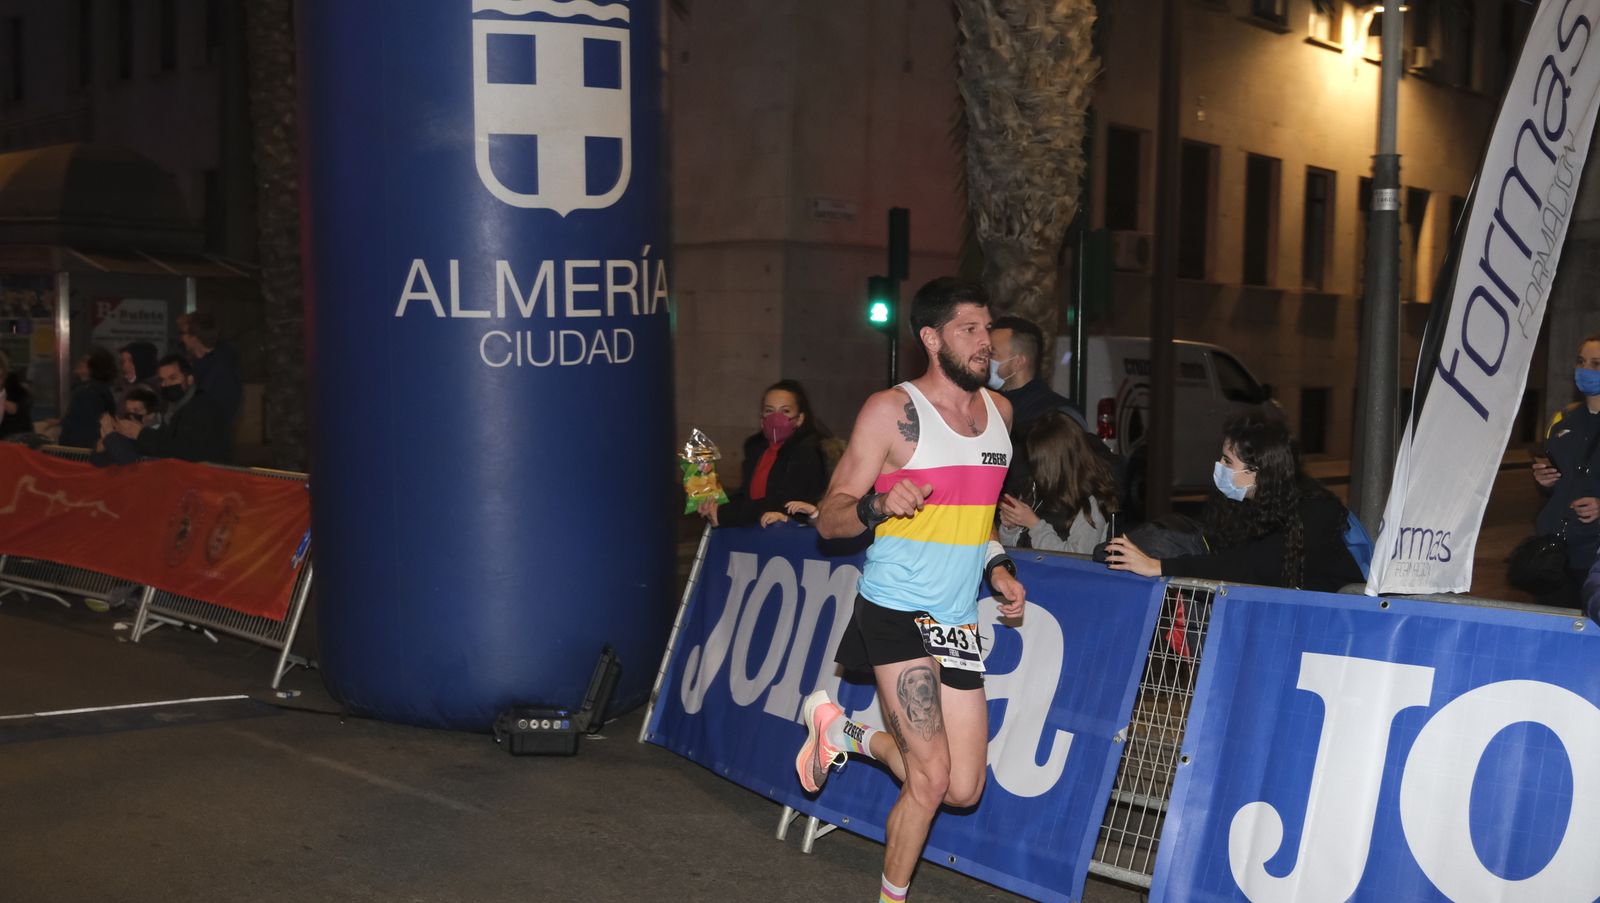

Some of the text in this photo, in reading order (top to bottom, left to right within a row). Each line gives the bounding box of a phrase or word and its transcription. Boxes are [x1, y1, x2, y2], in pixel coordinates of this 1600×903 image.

[1436, 0, 1592, 422] formas
[1517, 128, 1577, 340] FORMACIÓN
[395, 244, 670, 318] ALMERÍA
[479, 328, 635, 368] CIUDAD
[981, 451, 1007, 466] 226ERS
[929, 625, 969, 651] 343
[842, 720, 865, 744] 226ERS
